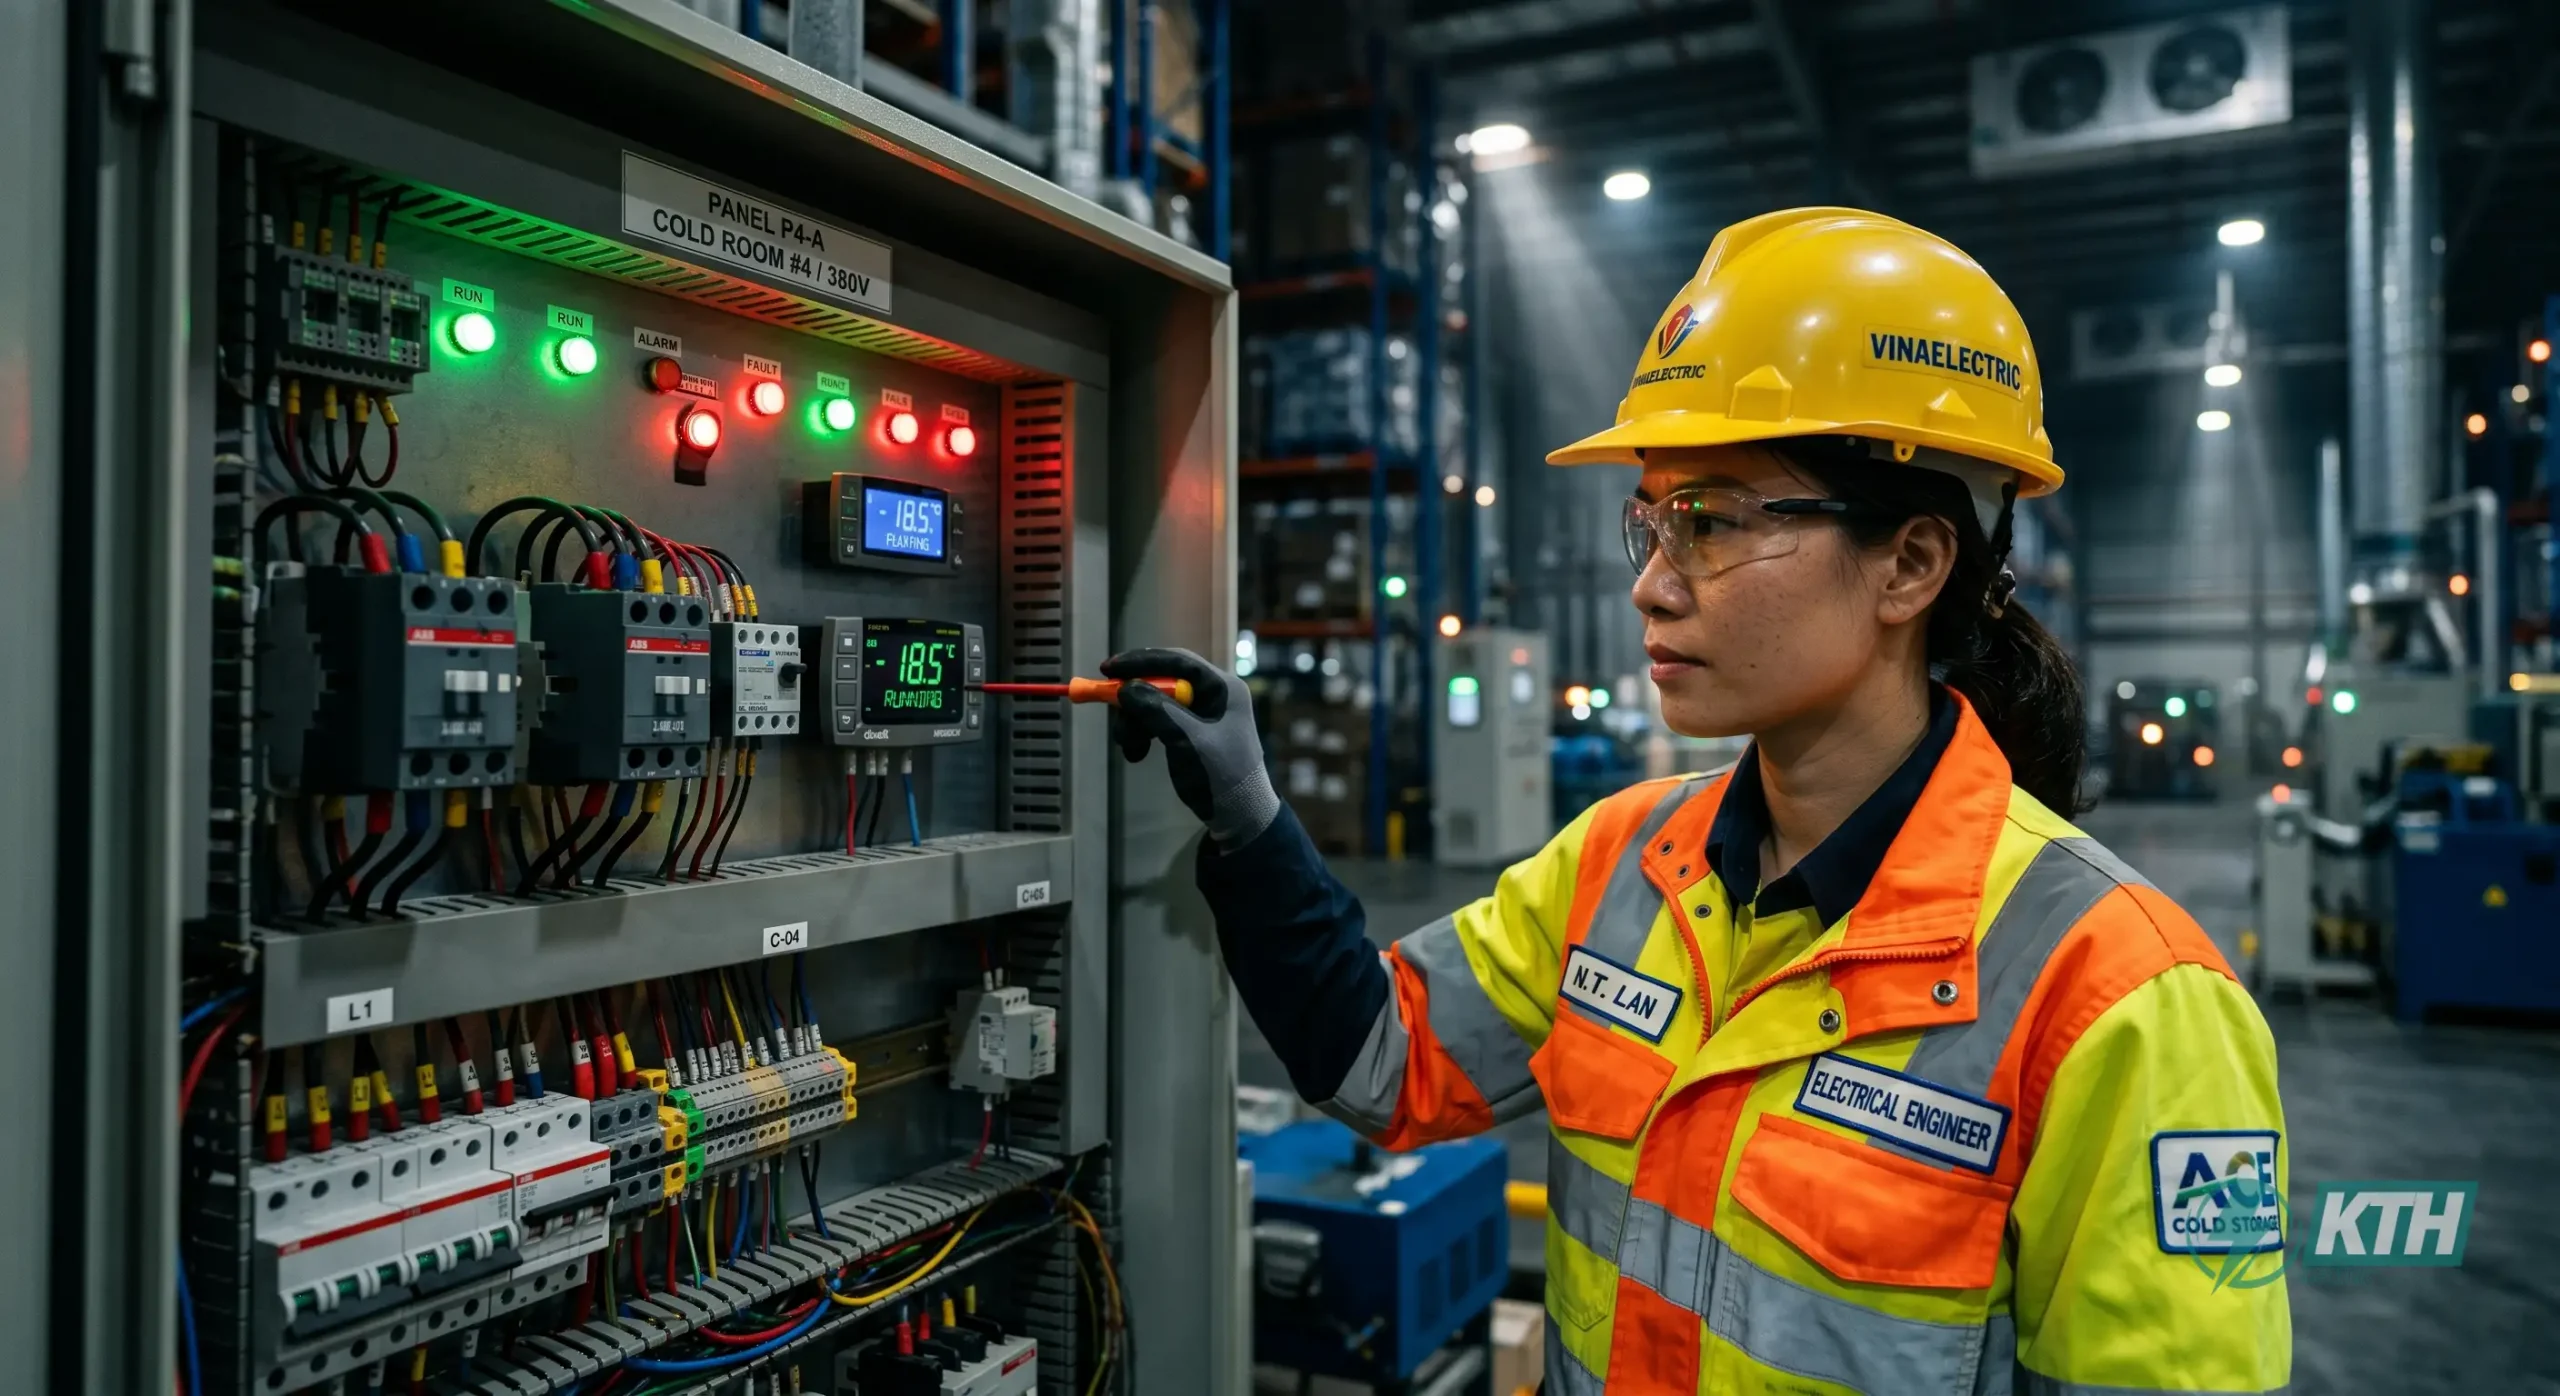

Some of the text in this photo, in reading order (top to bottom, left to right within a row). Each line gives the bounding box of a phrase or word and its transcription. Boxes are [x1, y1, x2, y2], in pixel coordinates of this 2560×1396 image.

[708, 191, 826, 252] PANEL P4-A
[653, 208, 870, 297] COLD ROOM #4 / 380V
[454, 286, 484, 304] RUN
[557, 312, 584, 328] RUN
[638, 332, 678, 352] ALARM
[746, 359, 779, 376] FAULT
[1870, 332, 2021, 392] VINAELECTRIC
[770, 929, 799, 947] C-04
[1573, 964, 1658, 1020] N.T. LAN
[349, 1000, 372, 1020] L1
[1810, 1070, 1992, 1152] ELECTRICAL ENGINEER
[2172, 1150, 2276, 1210] ACE
[2172, 1214, 2280, 1234] COLD STORAGE
